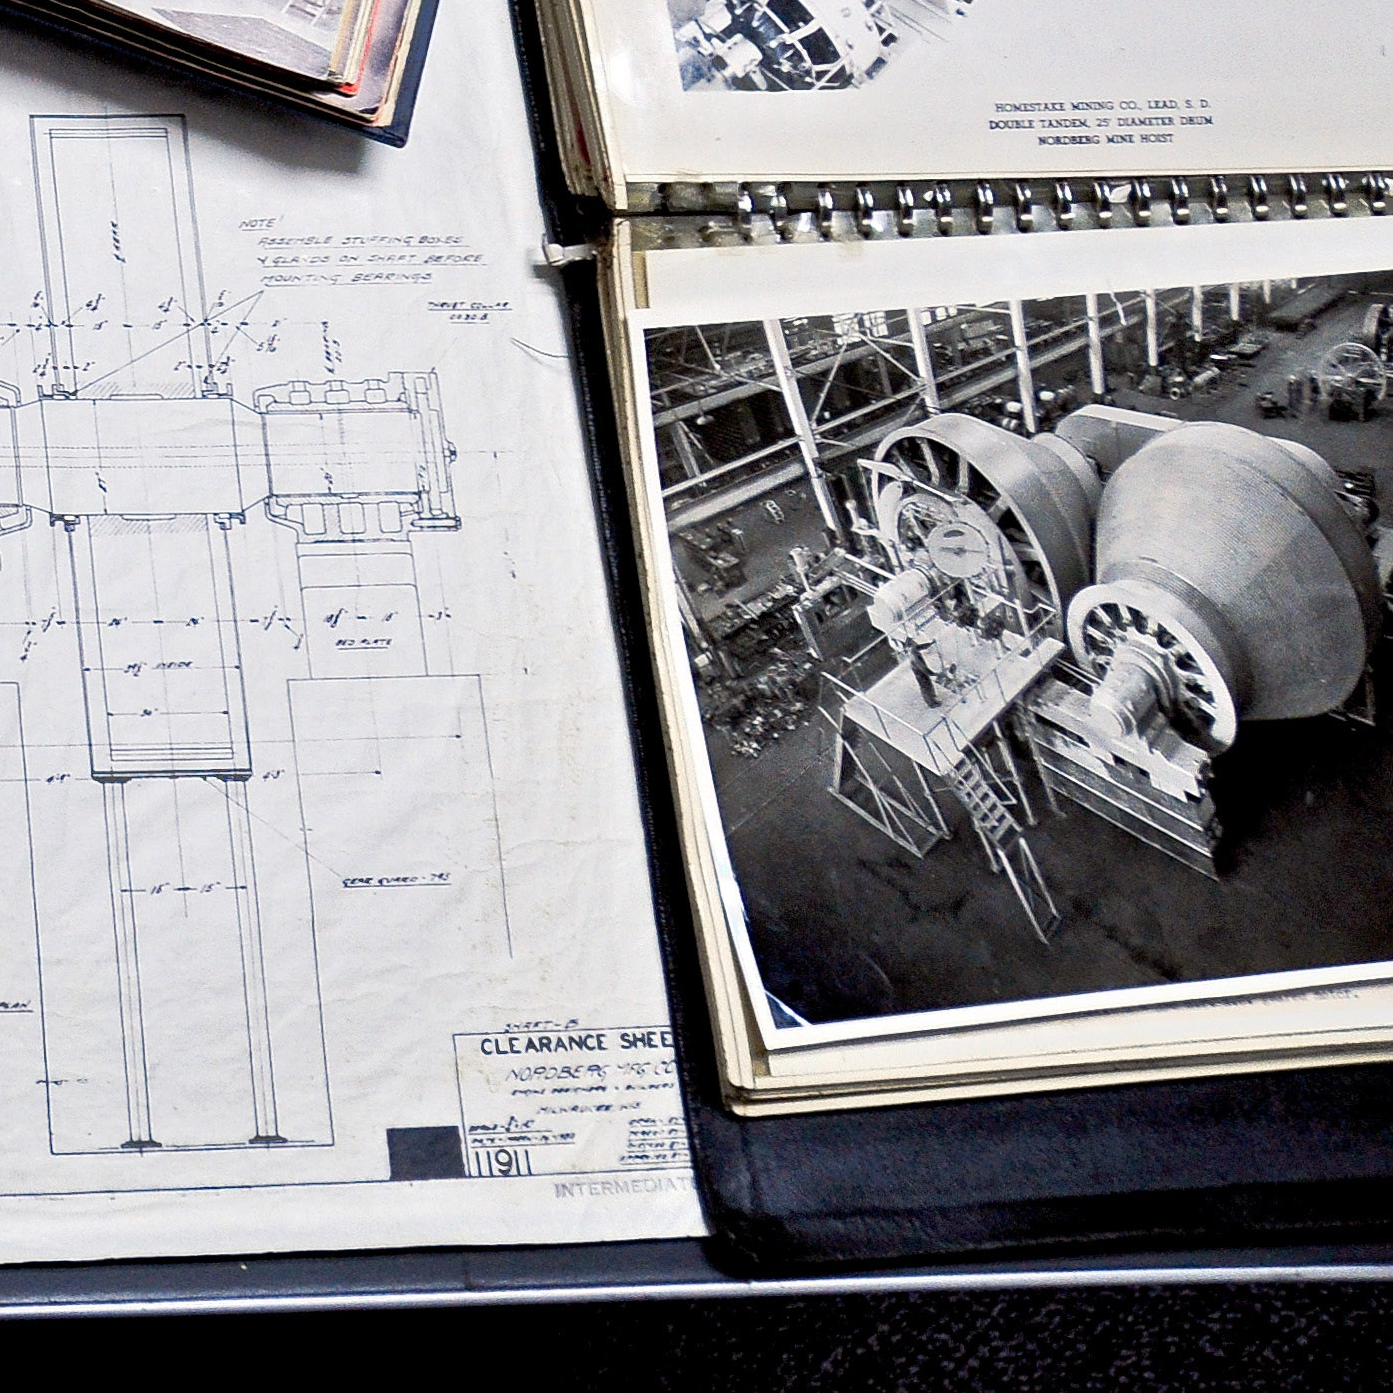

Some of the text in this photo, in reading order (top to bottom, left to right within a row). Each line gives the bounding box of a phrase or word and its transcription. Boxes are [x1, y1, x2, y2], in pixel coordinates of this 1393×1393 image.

[995, 102, 1066, 113] HOMESTAKE
[1070, 101, 1114, 111] MINING
[1185, 99, 1194, 109] S.
[1200, 99, 1211, 108] D.
[988, 119, 1035, 130] DOUBLE
[1117, 116, 1175, 127] DIAMETER
[1179, 116, 1214, 125] DRUM
[1037, 133, 1174, 146] NORDBERG MINE HOIST
[480, 1033, 608, 1055] CLEARANCE
